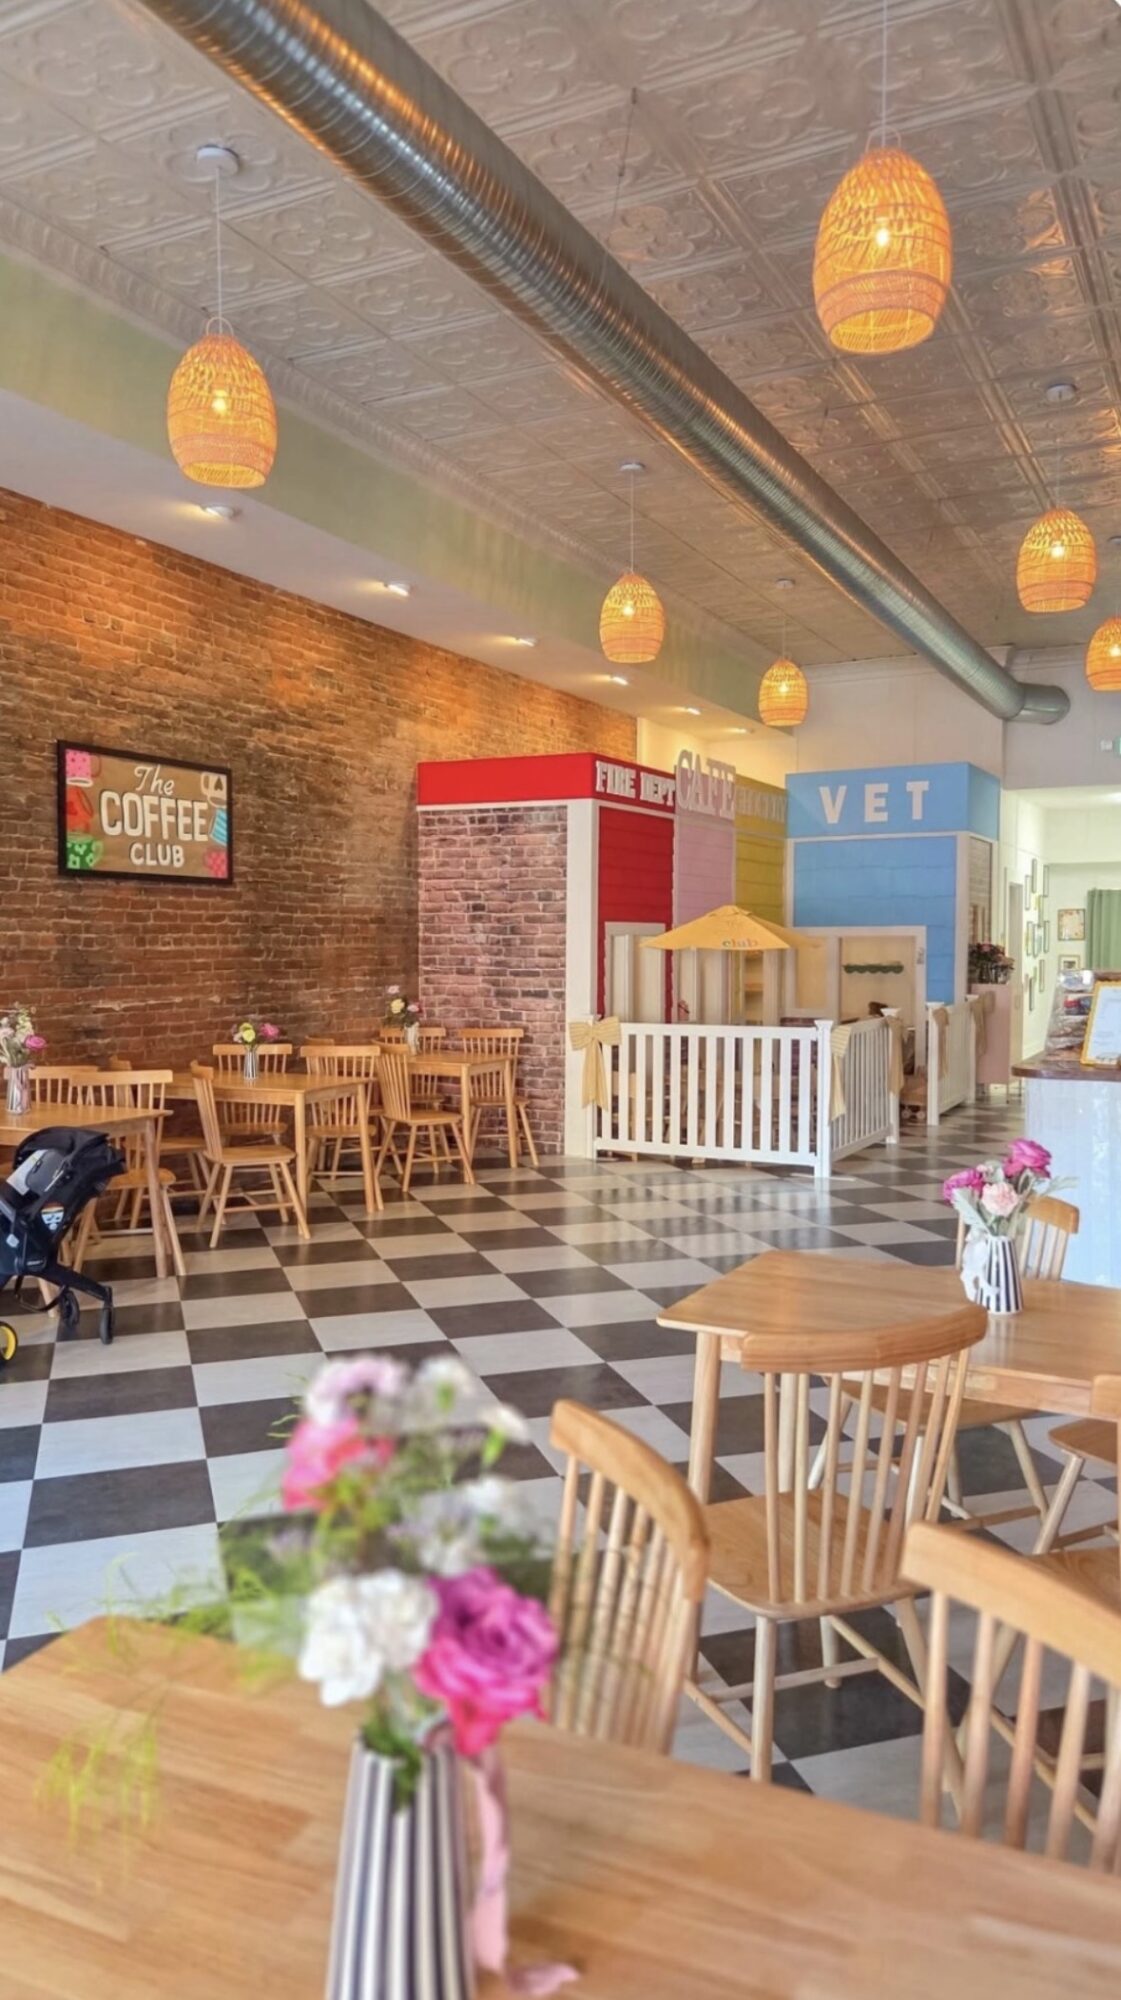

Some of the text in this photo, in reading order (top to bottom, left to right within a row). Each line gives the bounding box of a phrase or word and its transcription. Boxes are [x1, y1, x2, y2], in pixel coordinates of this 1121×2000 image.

[134, 764, 175, 796] The
[595, 760, 676, 807] FIRE DEPT
[676, 750, 736, 820] CAFE
[101, 791, 209, 841] COFFEE
[820, 781, 929, 824] VET
[130, 843, 185, 868] CLUB
[722, 938, 759, 949] club
